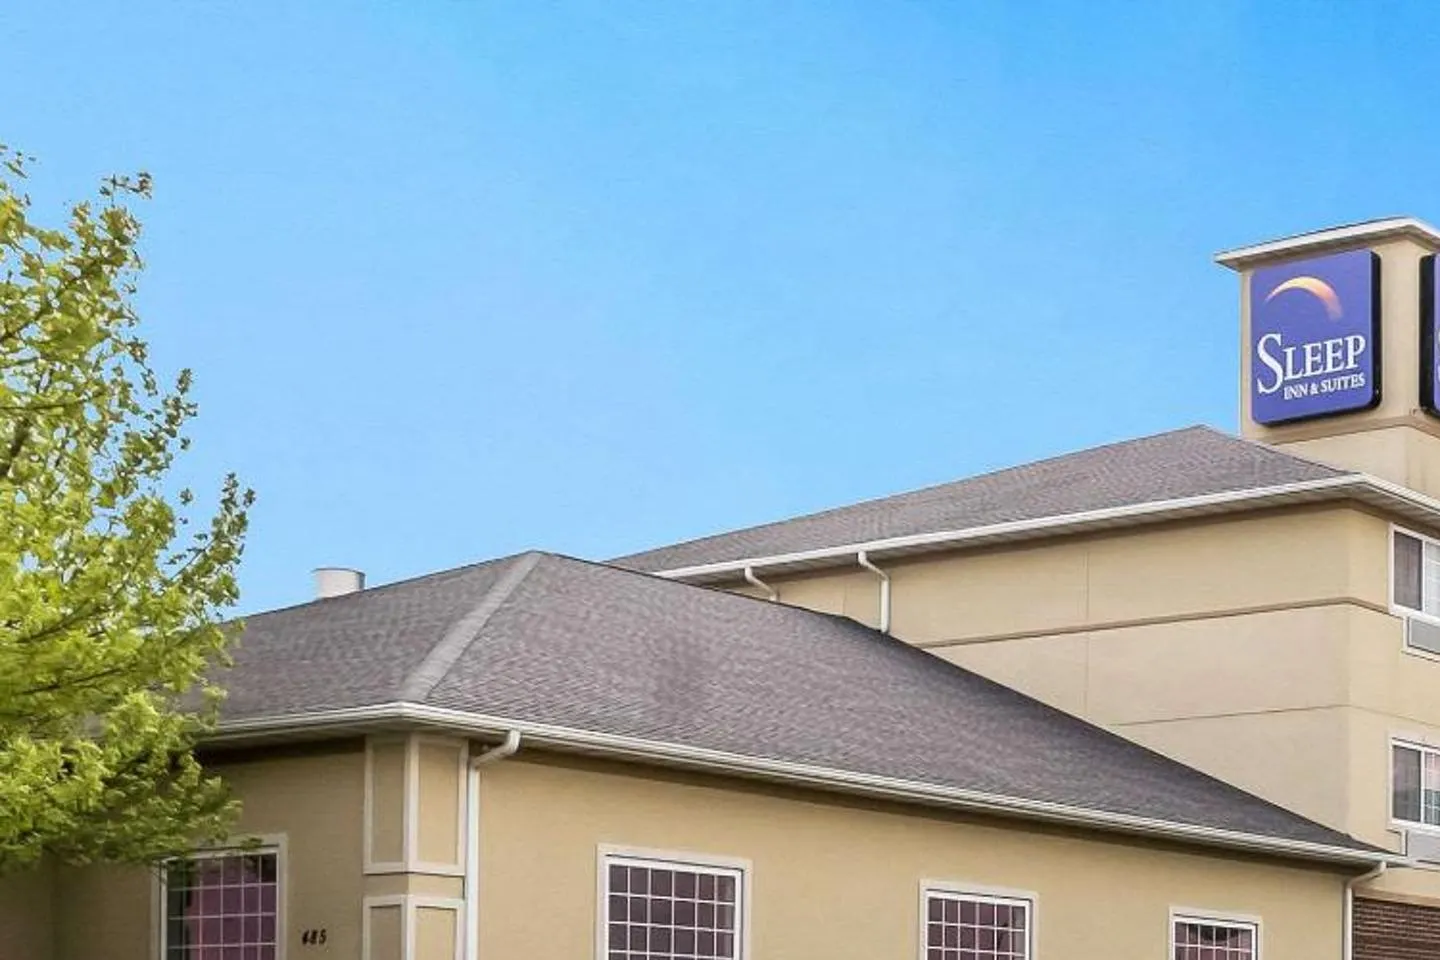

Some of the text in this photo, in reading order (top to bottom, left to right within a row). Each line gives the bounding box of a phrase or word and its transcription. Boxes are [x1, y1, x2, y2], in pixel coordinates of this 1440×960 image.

[1257, 333, 1366, 393] SLEEP
[1284, 372, 1366, 400] INN & SUITES
